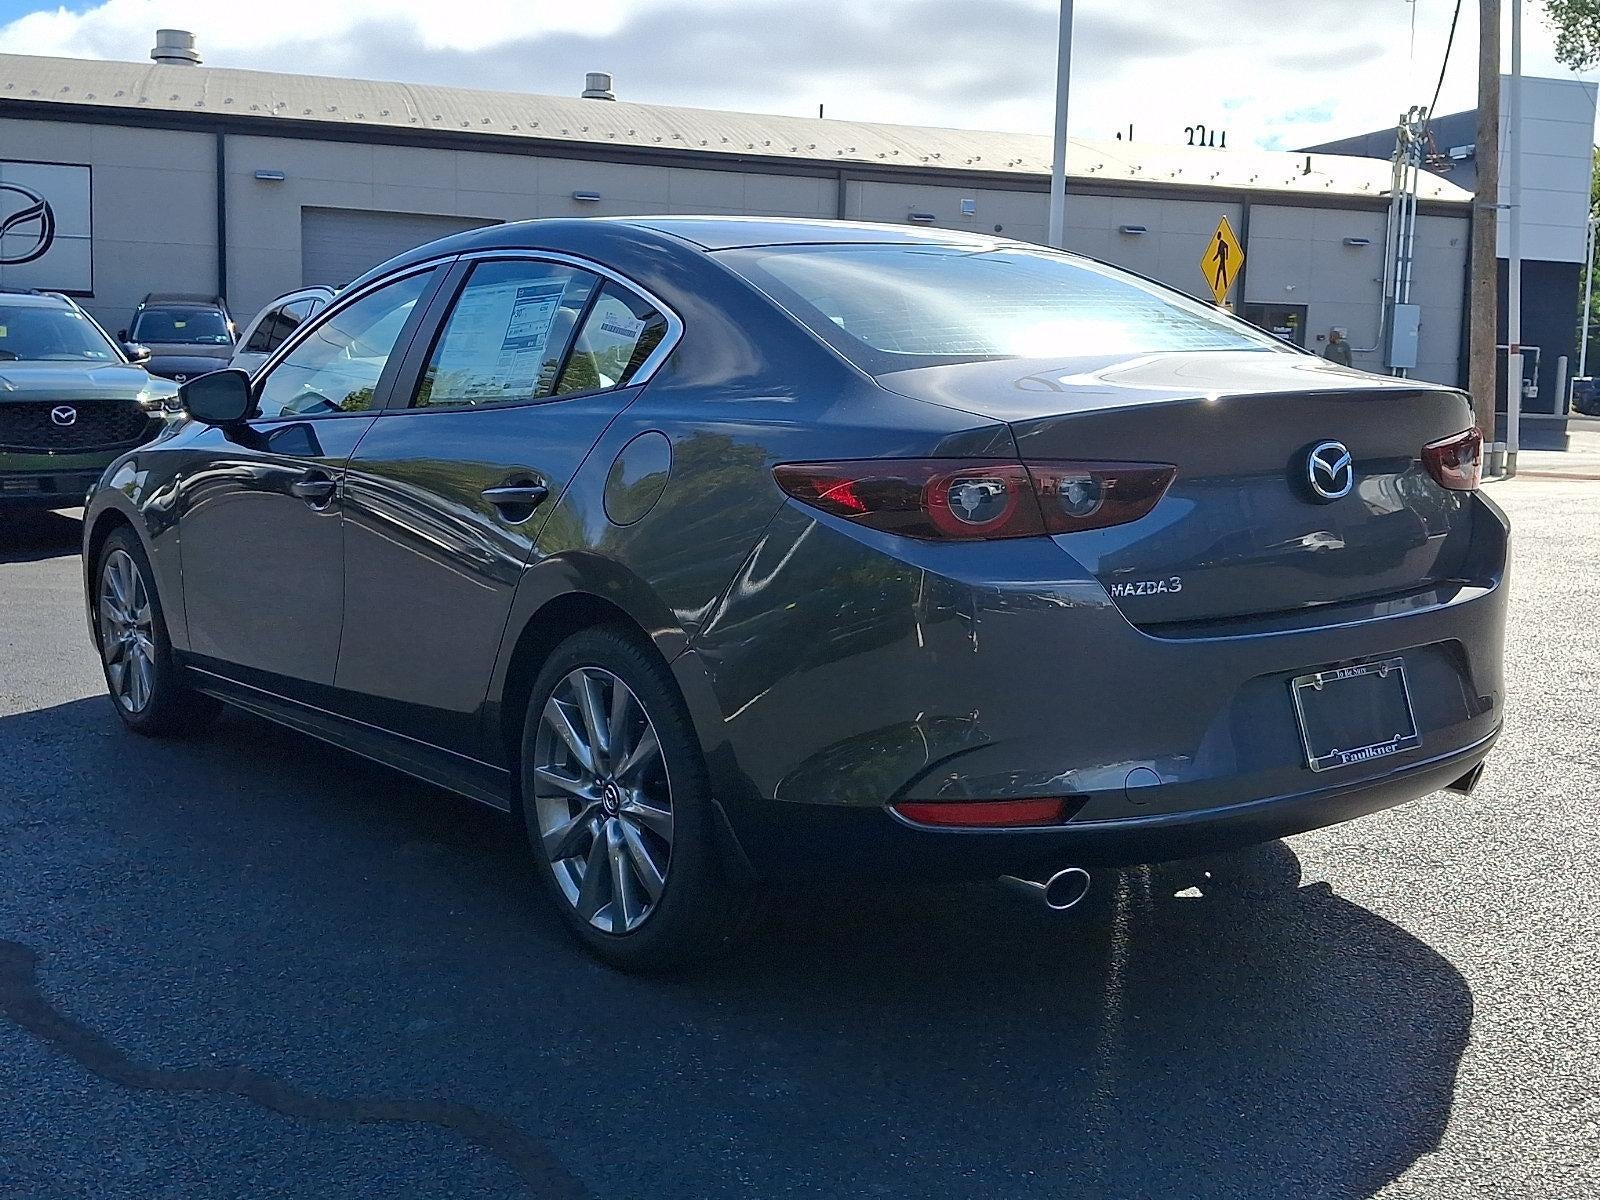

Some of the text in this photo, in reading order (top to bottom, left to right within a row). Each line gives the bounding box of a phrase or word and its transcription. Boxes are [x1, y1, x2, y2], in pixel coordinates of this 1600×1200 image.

[1111, 576, 1182, 597] MAZDA3
[1336, 669, 1343, 679] To
[1345, 669, 1352, 677] Be
[1341, 744, 1398, 764] Faulkner
